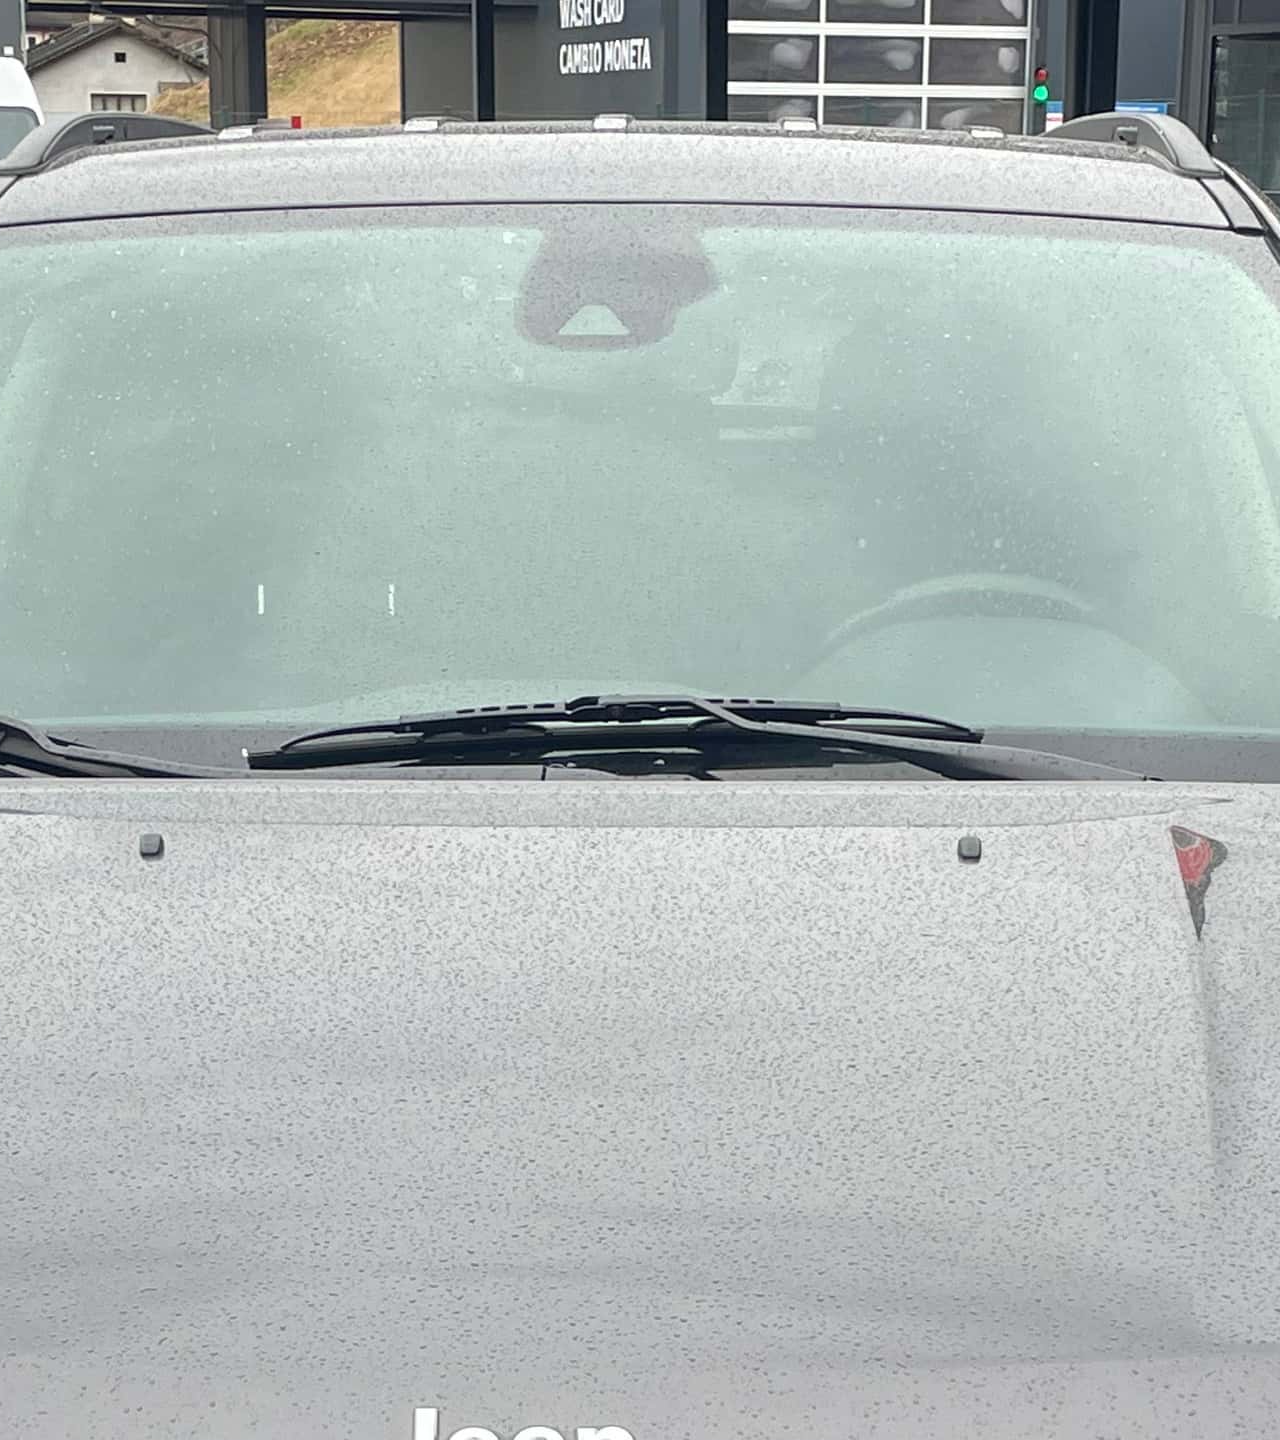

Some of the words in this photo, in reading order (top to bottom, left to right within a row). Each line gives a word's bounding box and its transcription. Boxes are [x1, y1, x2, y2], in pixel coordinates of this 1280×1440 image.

[559, 0, 592, 29] WASH
[593, 0, 625, 25] CARD
[560, 41, 602, 75] CAMBIO
[604, 37, 652, 72] MONETA
